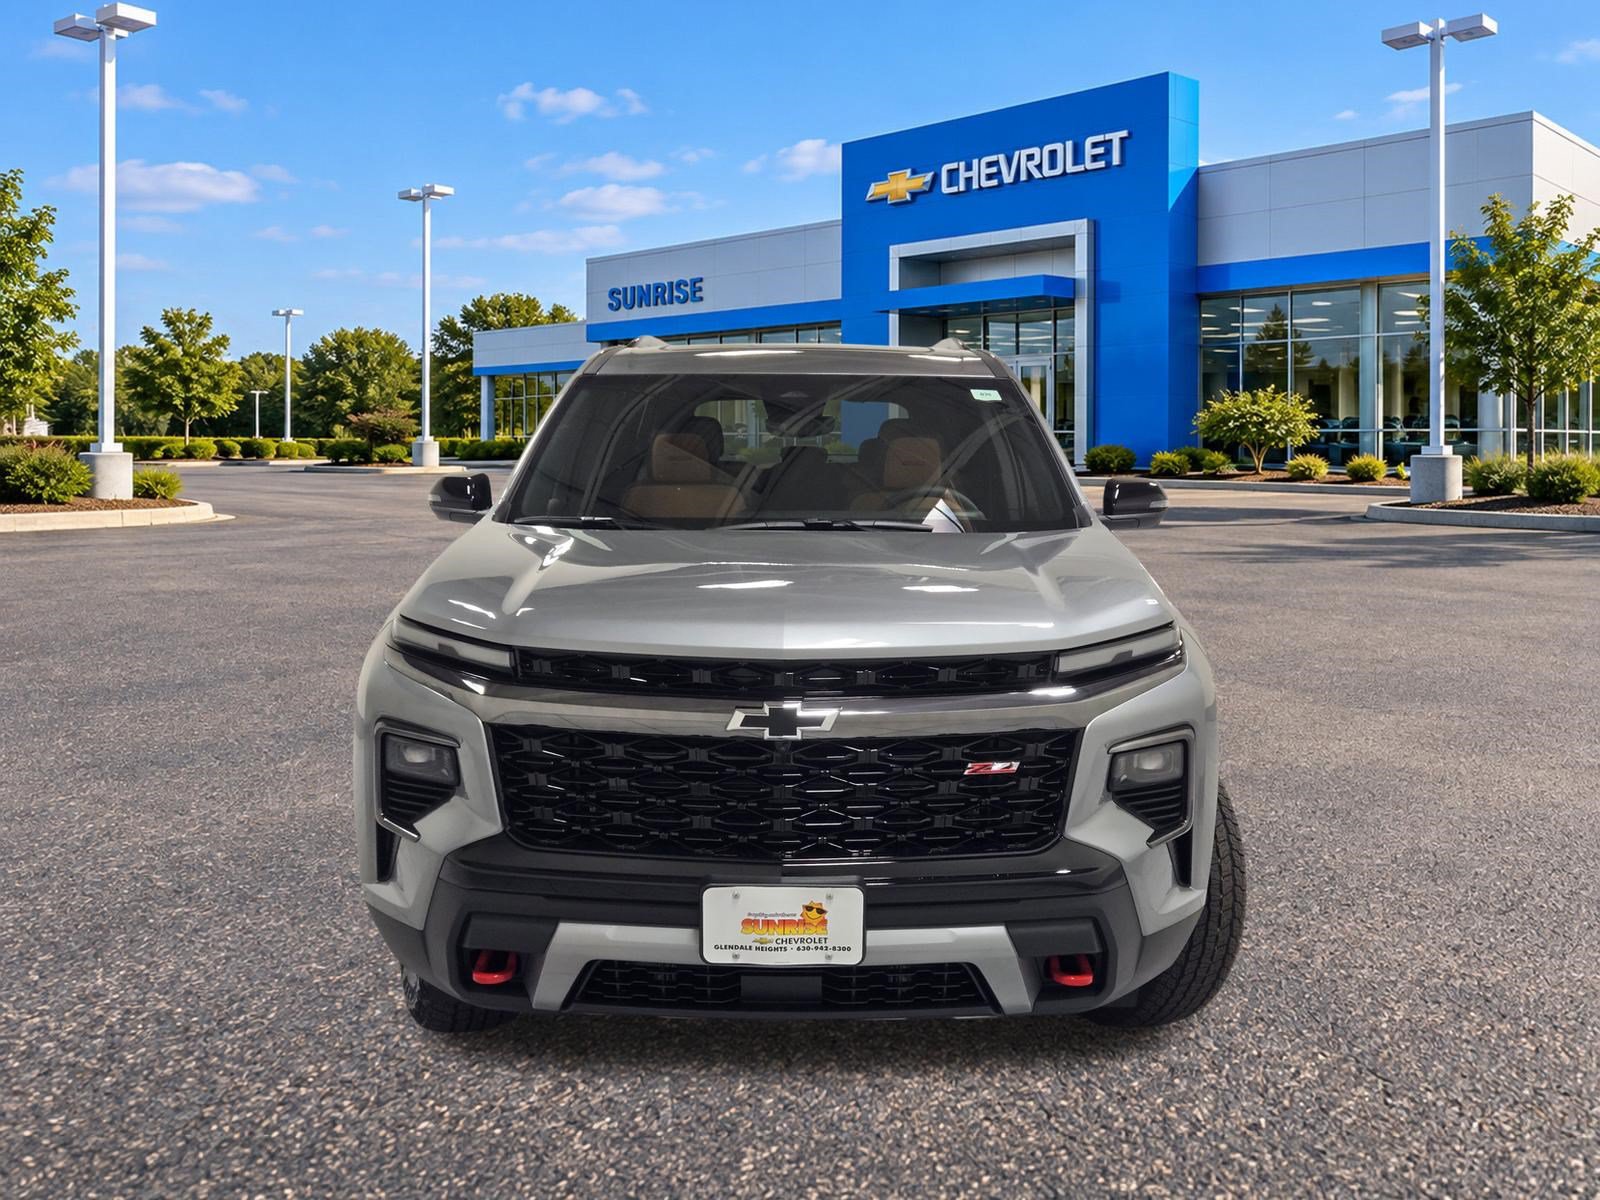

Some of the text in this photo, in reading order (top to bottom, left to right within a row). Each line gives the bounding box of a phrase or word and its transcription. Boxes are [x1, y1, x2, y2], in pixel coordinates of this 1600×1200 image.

[941, 130, 1129, 195] CHEVROLET
[608, 277, 704, 312] SUNRISE
[741, 918, 828, 936] SUNRISE
[775, 937, 828, 945] CHEVROLET
